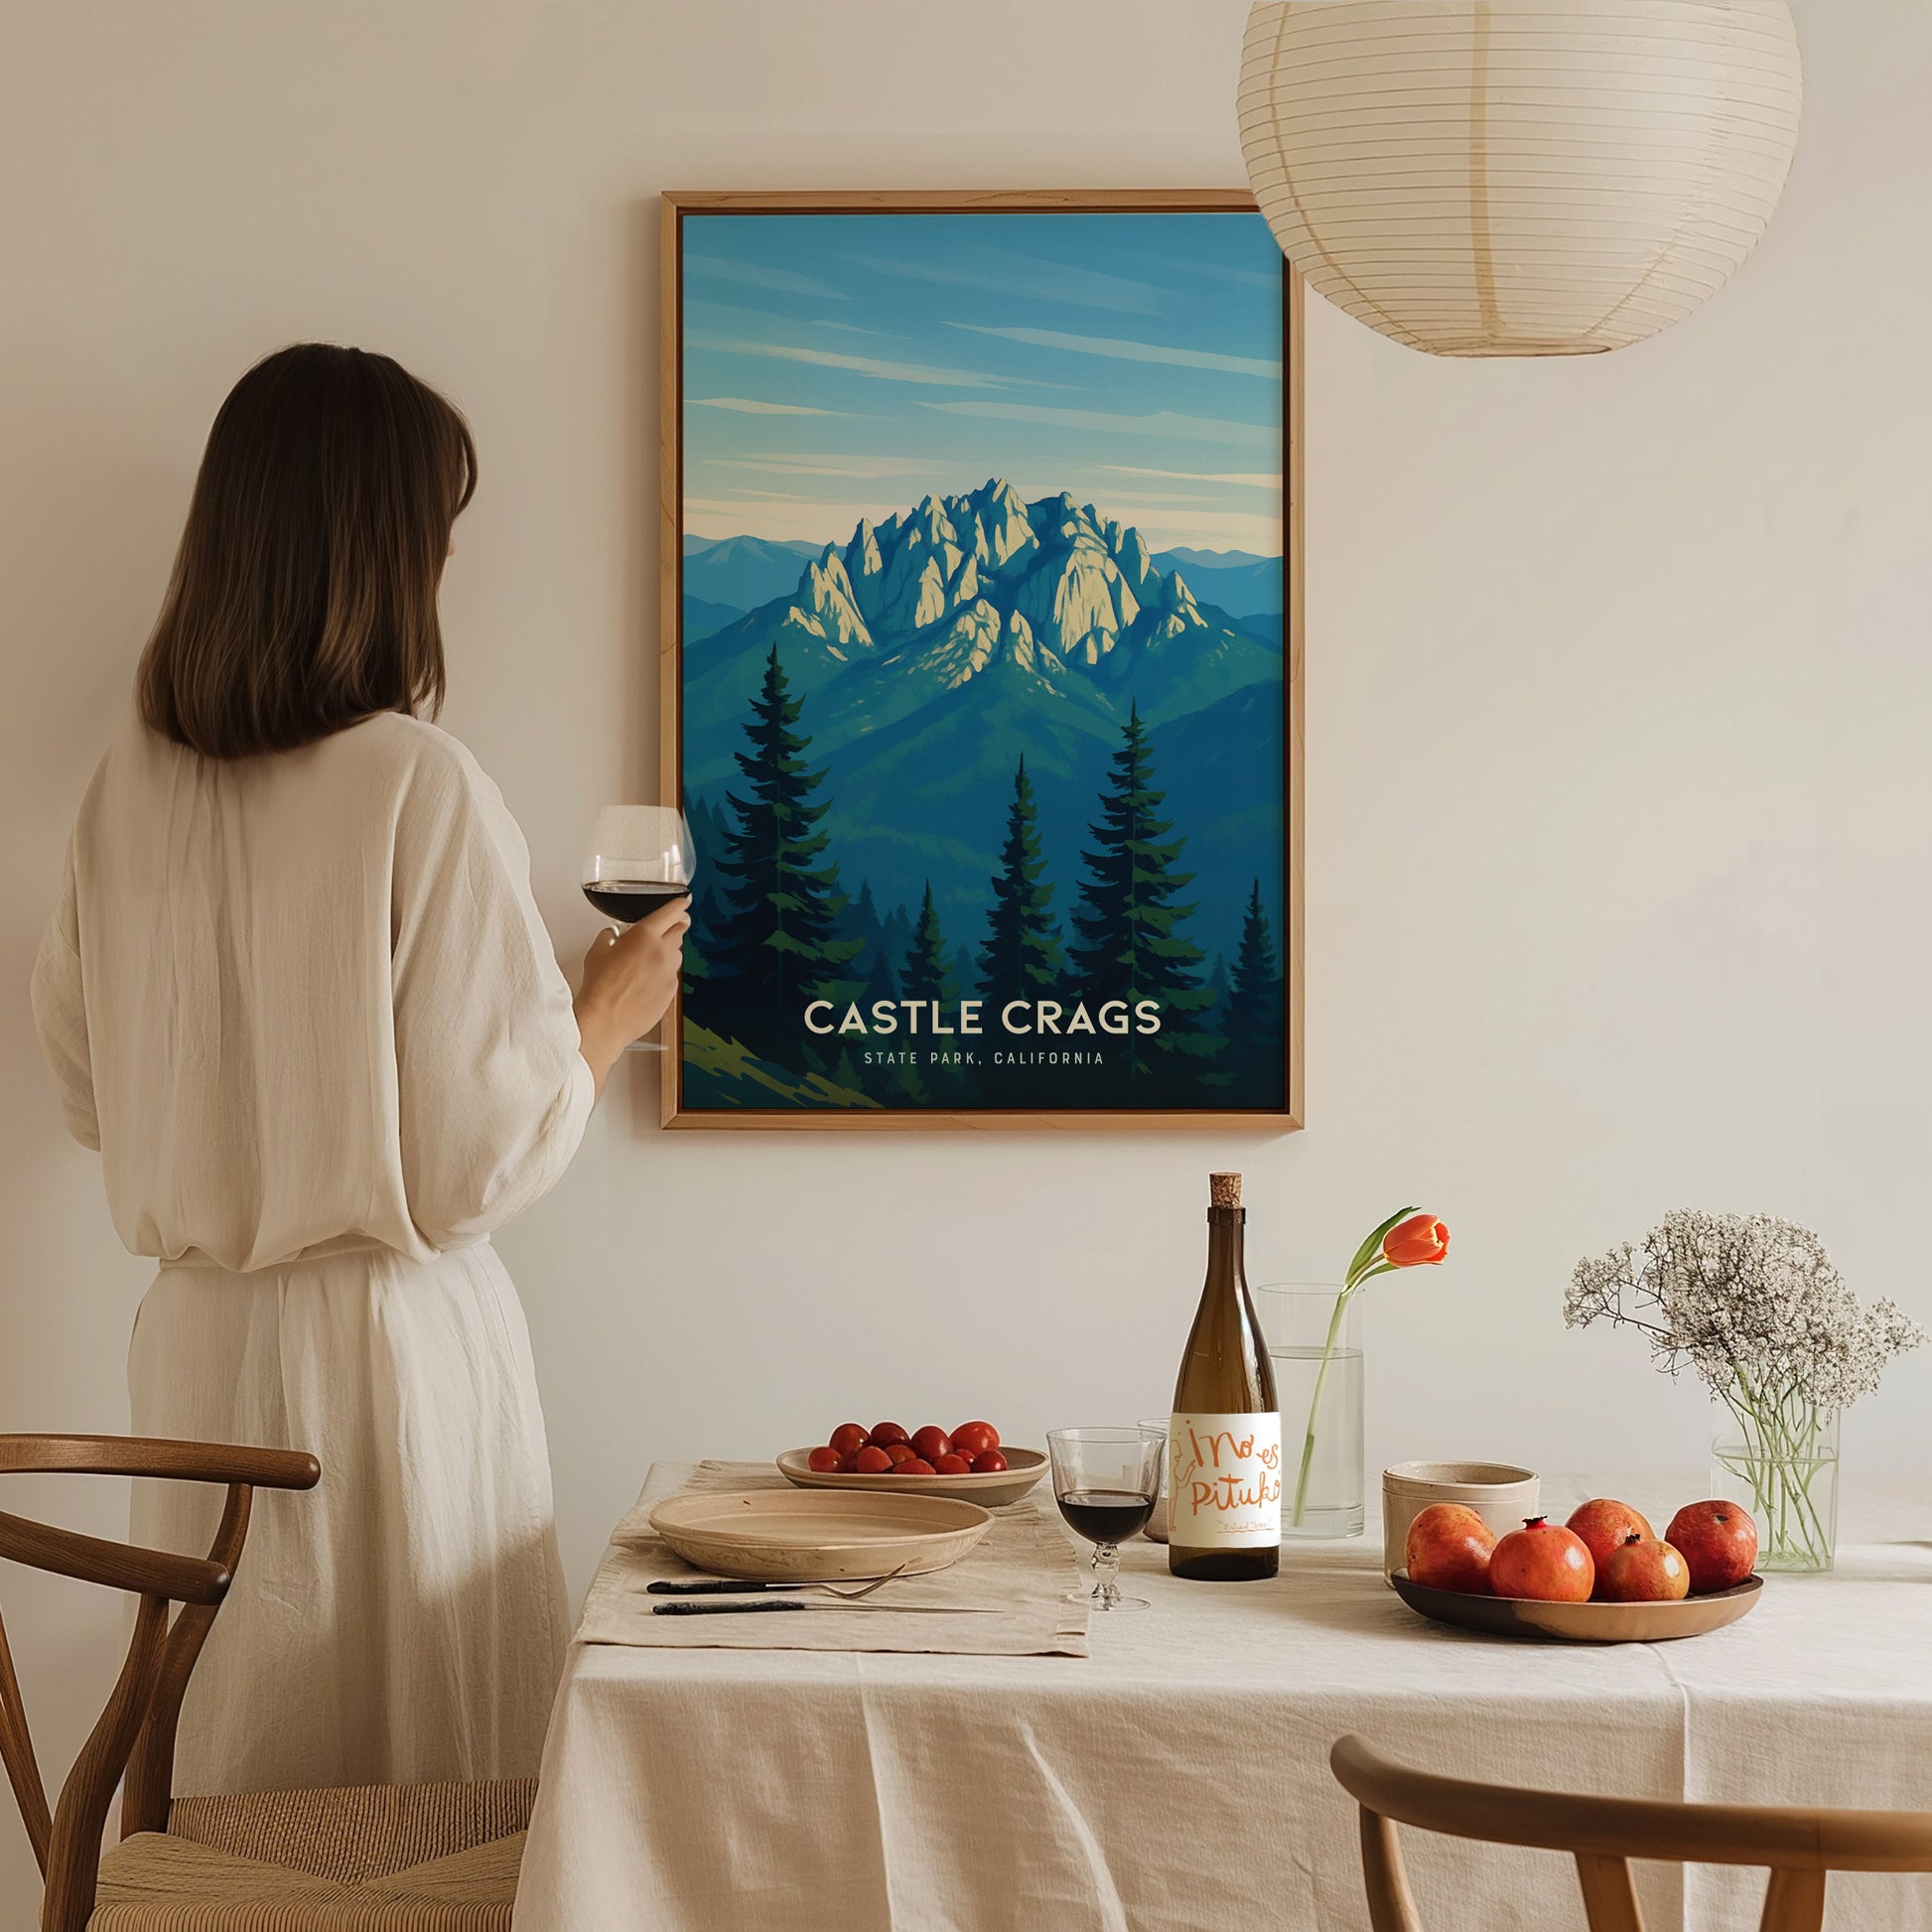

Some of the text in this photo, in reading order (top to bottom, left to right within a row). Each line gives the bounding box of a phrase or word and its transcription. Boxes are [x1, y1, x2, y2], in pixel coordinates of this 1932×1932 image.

[805, 1001, 1161, 1034] CASTLE CRAGS
[865, 1052, 1102, 1064] STATE PARK, CALIFORNIA
